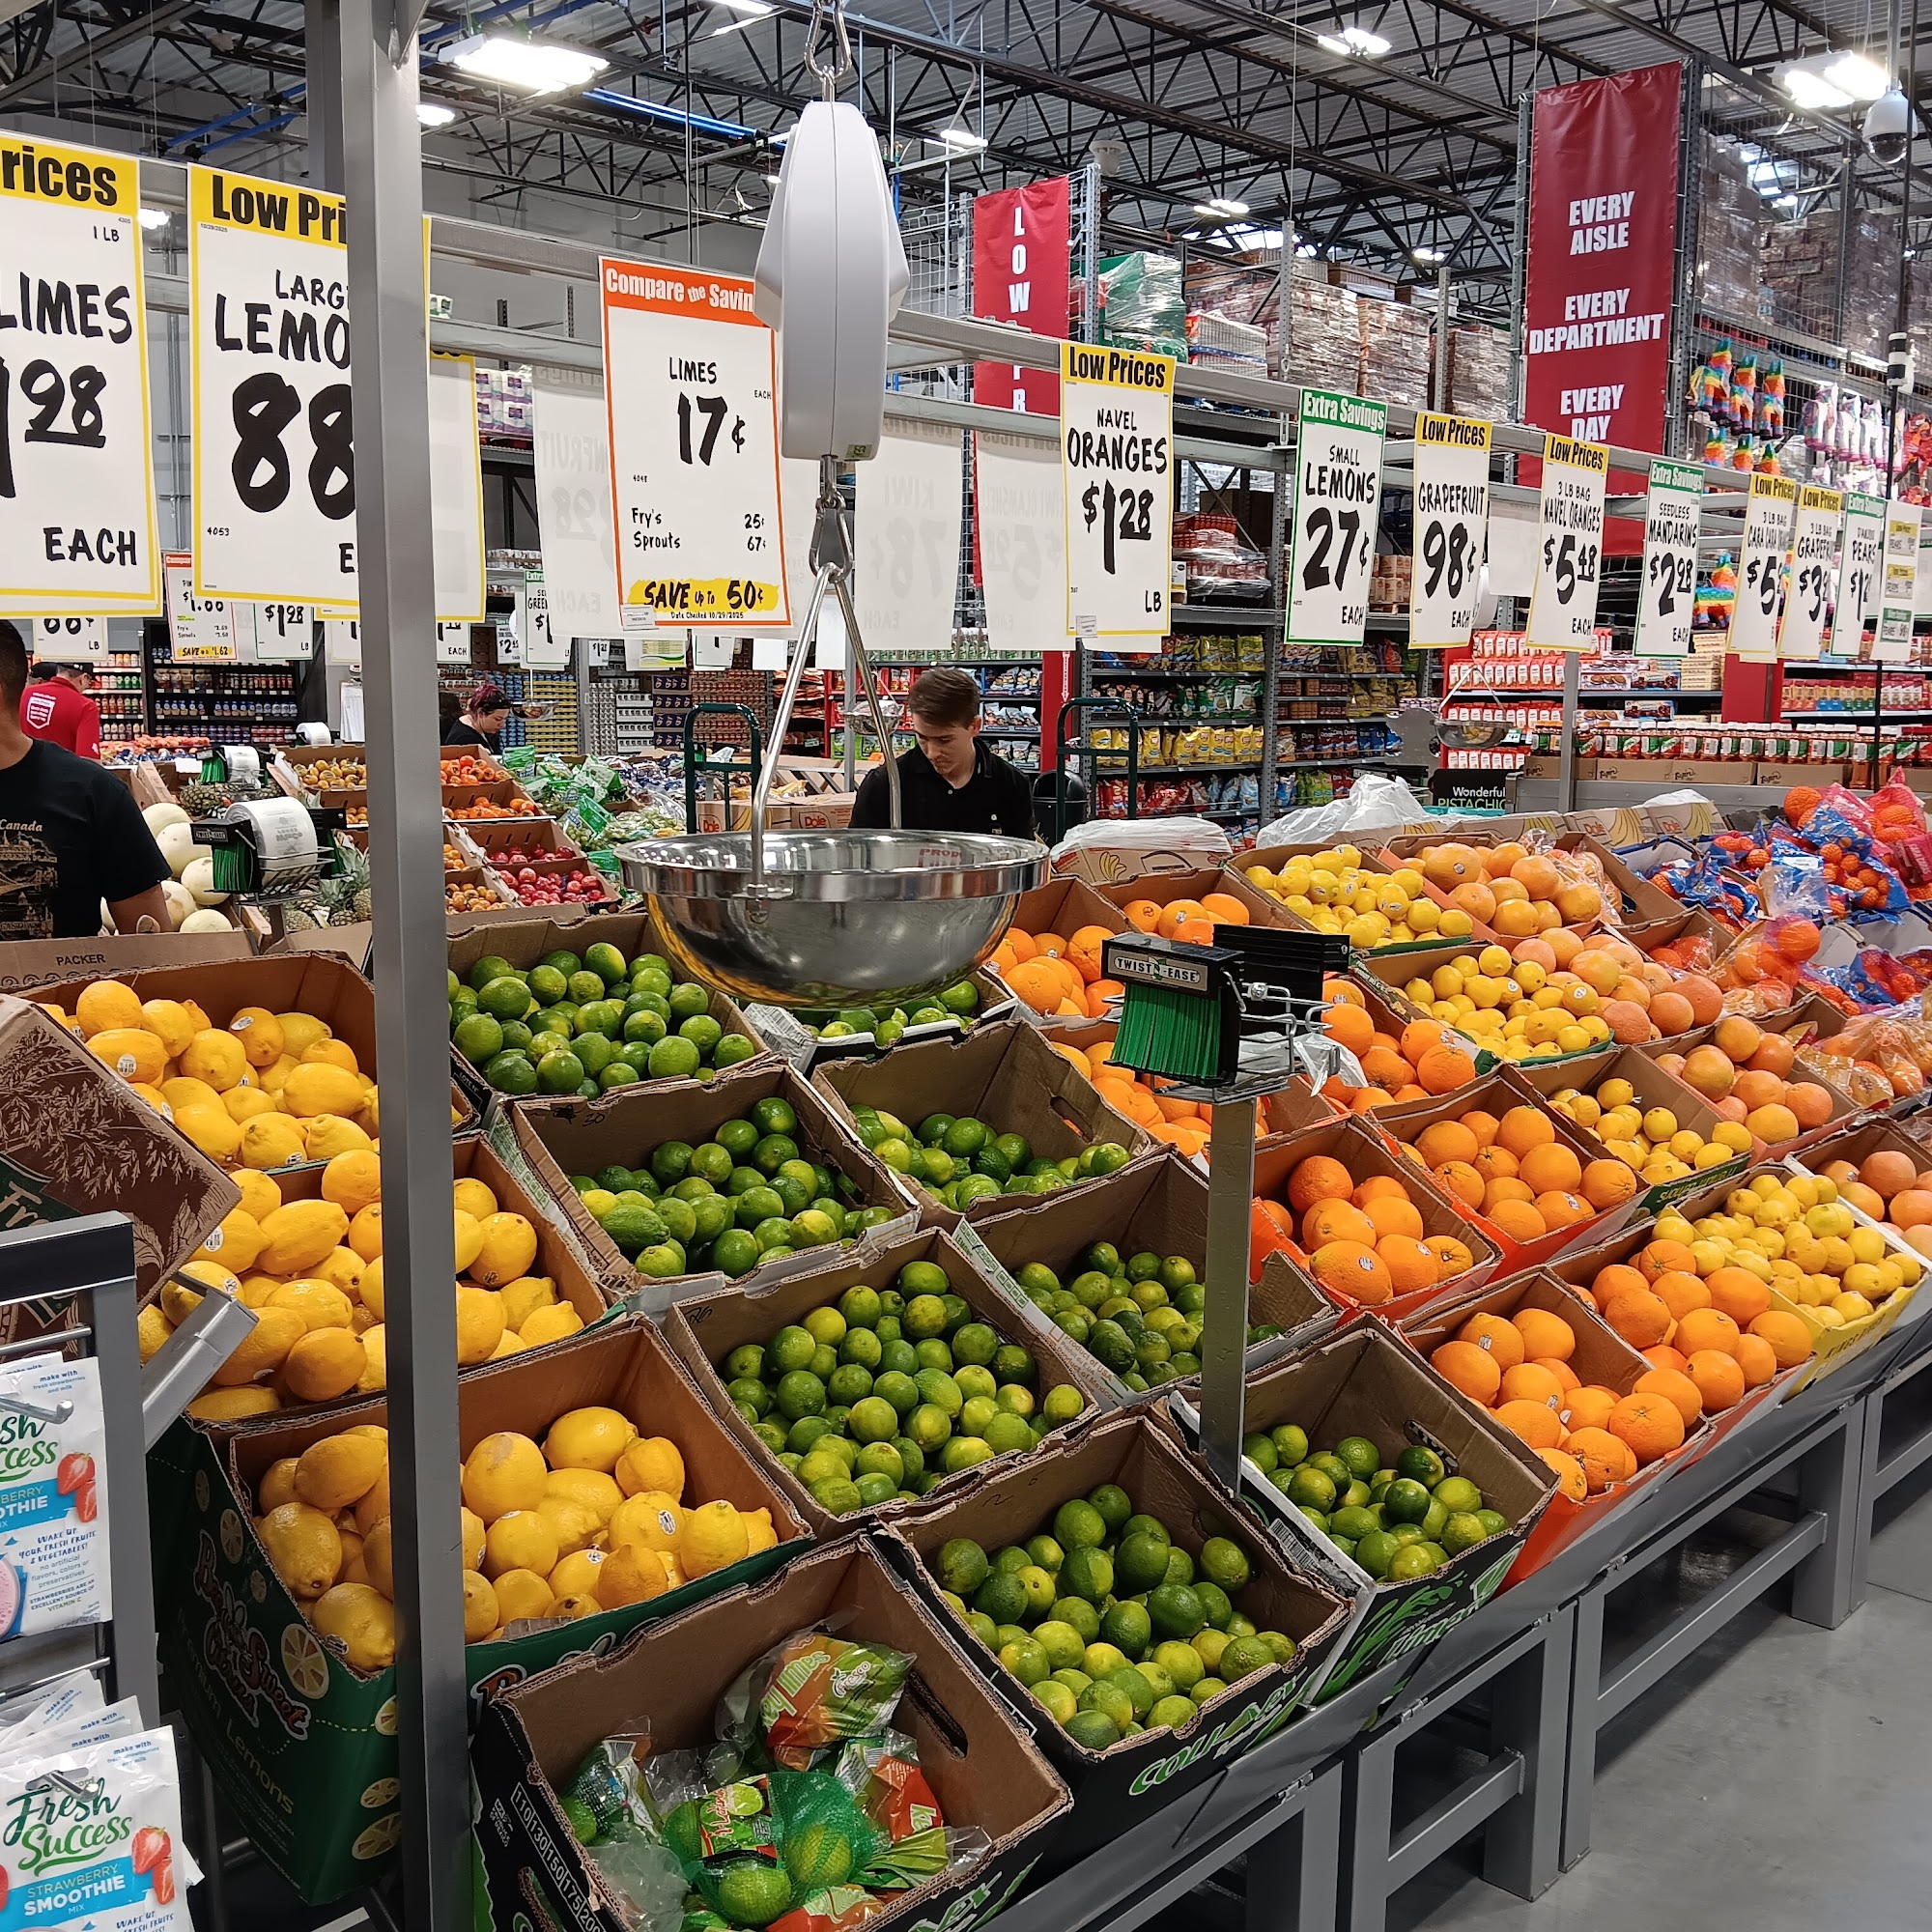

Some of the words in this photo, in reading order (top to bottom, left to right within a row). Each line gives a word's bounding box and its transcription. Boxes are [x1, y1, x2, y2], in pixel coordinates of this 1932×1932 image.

[2, 145, 117, 206] rices
[213, 175, 288, 231] Low
[298, 192, 348, 244] Pri
[1569, 190, 1634, 227] EVERY
[94, 225, 98, 240] 1
[103, 227, 120, 242] LB
[1570, 221, 1630, 256] AISLE
[275, 269, 349, 310] LARG
[606, 268, 684, 303] Compare
[688, 286, 706, 303] the
[709, 284, 753, 312] Savin
[1565, 288, 1630, 321] EVERY
[215, 294, 351, 369] LEMO
[1528, 314, 1665, 355] DEPARTMENT
[669, 356, 717, 384] LIMES
[1070, 346, 1105, 381] Low
[1109, 352, 1166, 387] Prices
[754, 390, 771, 400] EACH
[1560, 384, 1624, 415] EVERY
[1097, 408, 1137, 431] NAVEL
[1303, 392, 1338, 420] Extra
[1340, 398, 1384, 431] Savings
[677, 392, 745, 466] 17¢
[1422, 415, 1446, 441] Low
[1448, 419, 1485, 446] Prices
[1571, 415, 1611, 440] DAY
[1067, 427, 1167, 474] ORANGES
[1329, 444, 1359, 466] SMALL
[1550, 437, 1571, 462] Low
[1572, 442, 1604, 469] Prices
[1306, 462, 1376, 504] LEMONS
[1652, 463, 1671, 485] Extra
[1672, 467, 1702, 491] Savings
[1755, 475, 1772, 495] Low
[1774, 478, 1794, 499] Prices
[1419, 482, 1485, 515] GRAPEFRUIT
[1558, 481, 1562, 496] 3
[1565, 482, 1573, 497] LB
[1576, 485, 1591, 501] BAG
[1804, 488, 1818, 507] Low
[1820, 491, 1839, 511] Prices
[632, 508, 662, 528] Fry's
[745, 514, 764, 528] 25¢
[1545, 497, 1567, 526] NAVEL
[1570, 501, 1601, 533] ORANGES
[1660, 502, 1690, 520] SEEDLESS
[1763, 512, 1767, 524] 3
[1769, 512, 1775, 524] LB
[207, 526, 230, 536] 4053
[1649, 519, 1697, 548] MANDARINS
[1810, 523, 1814, 534] 3
[43, 526, 137, 566] EACH
[634, 531, 680, 551] Sprouts
[747, 536, 766, 551] 67¢
[1302, 507, 1369, 591] 27¢
[1798, 536, 1834, 561] GRAPEFR
[1852, 540, 1876, 564] PEARS
[1424, 521, 1476, 599] 98¢
[644, 581, 690, 609] SAVE
[726, 581, 764, 610] 50¢
[1146, 590, 1161, 612] LB
[1342, 606, 1364, 626] EACH
[1452, 611, 1471, 628] EACH
[1572, 618, 1593, 636] EACH
[89, 640, 99, 650] LB
[1673, 627, 1689, 642] EACH
[183, 647, 200, 656] SAVE
[448, 647, 468, 656] EACH
[1453, 786, 1506, 797] Wonderful
[0, 819, 43, 832] Canada
[702, 819, 720, 833] Dole
[804, 815, 826, 828] Dole
[1583, 823, 1605, 835] Dole
[56, 953, 106, 966] PACKER
[1118, 958, 1151, 973] TWIST
[62, 1370, 78, 1378] with
[1097, 1364, 1114, 1381] USA
[1089, 1377, 1114, 1400] Mexico
[1, 1486, 43, 1503] BERRY
[0, 1495, 48, 1519] OTHIE
[19, 1548, 42, 1558] YOUR
[44, 1540, 68, 1550] FRESH
[71, 1530, 96, 1544] FRUITS
[38, 1531, 63, 1544] WAKE
[39, 1543, 88, 1562] VEGETABLES!
[51, 1555, 80, 1567] artificial
[31, 1571, 58, 1581] flavors,
[59, 1564, 80, 1574] colors
[39, 1570, 85, 1588] preservatives
[30, 1587, 74, 1604] STRAWBERRIES
[31, 1597, 64, 1610] EXCELLENT
[65, 1589, 87, 1599] SOURCE
[48, 1600, 75, 1611] VITAMIN
[45, 1701, 60, 1715] make
[61, 1690, 74, 1702] with
[80, 1719, 99, 1730] make
[101, 1712, 118, 1722] with
[71, 1739, 91, 1747] make
[94, 1733, 110, 1742] with
[113, 1747, 133, 1755] make
[135, 1741, 152, 1749] with
[3, 1777, 122, 1846] Fresh
[17, 1816, 132, 1870] Success
[515, 1791, 532, 1822] 110
[530, 1819, 548, 1851] 130
[546, 1848, 564, 1881] 150
[563, 1879, 582, 1911] 175
[27, 1862, 119, 1898] STRAWBERRY
[24, 1875, 126, 1917] SMOOTHIE
[68, 1904, 86, 1915] MIX
[150, 1913, 174, 1927] FRUITS
[116, 1916, 142, 1928] WAKE
